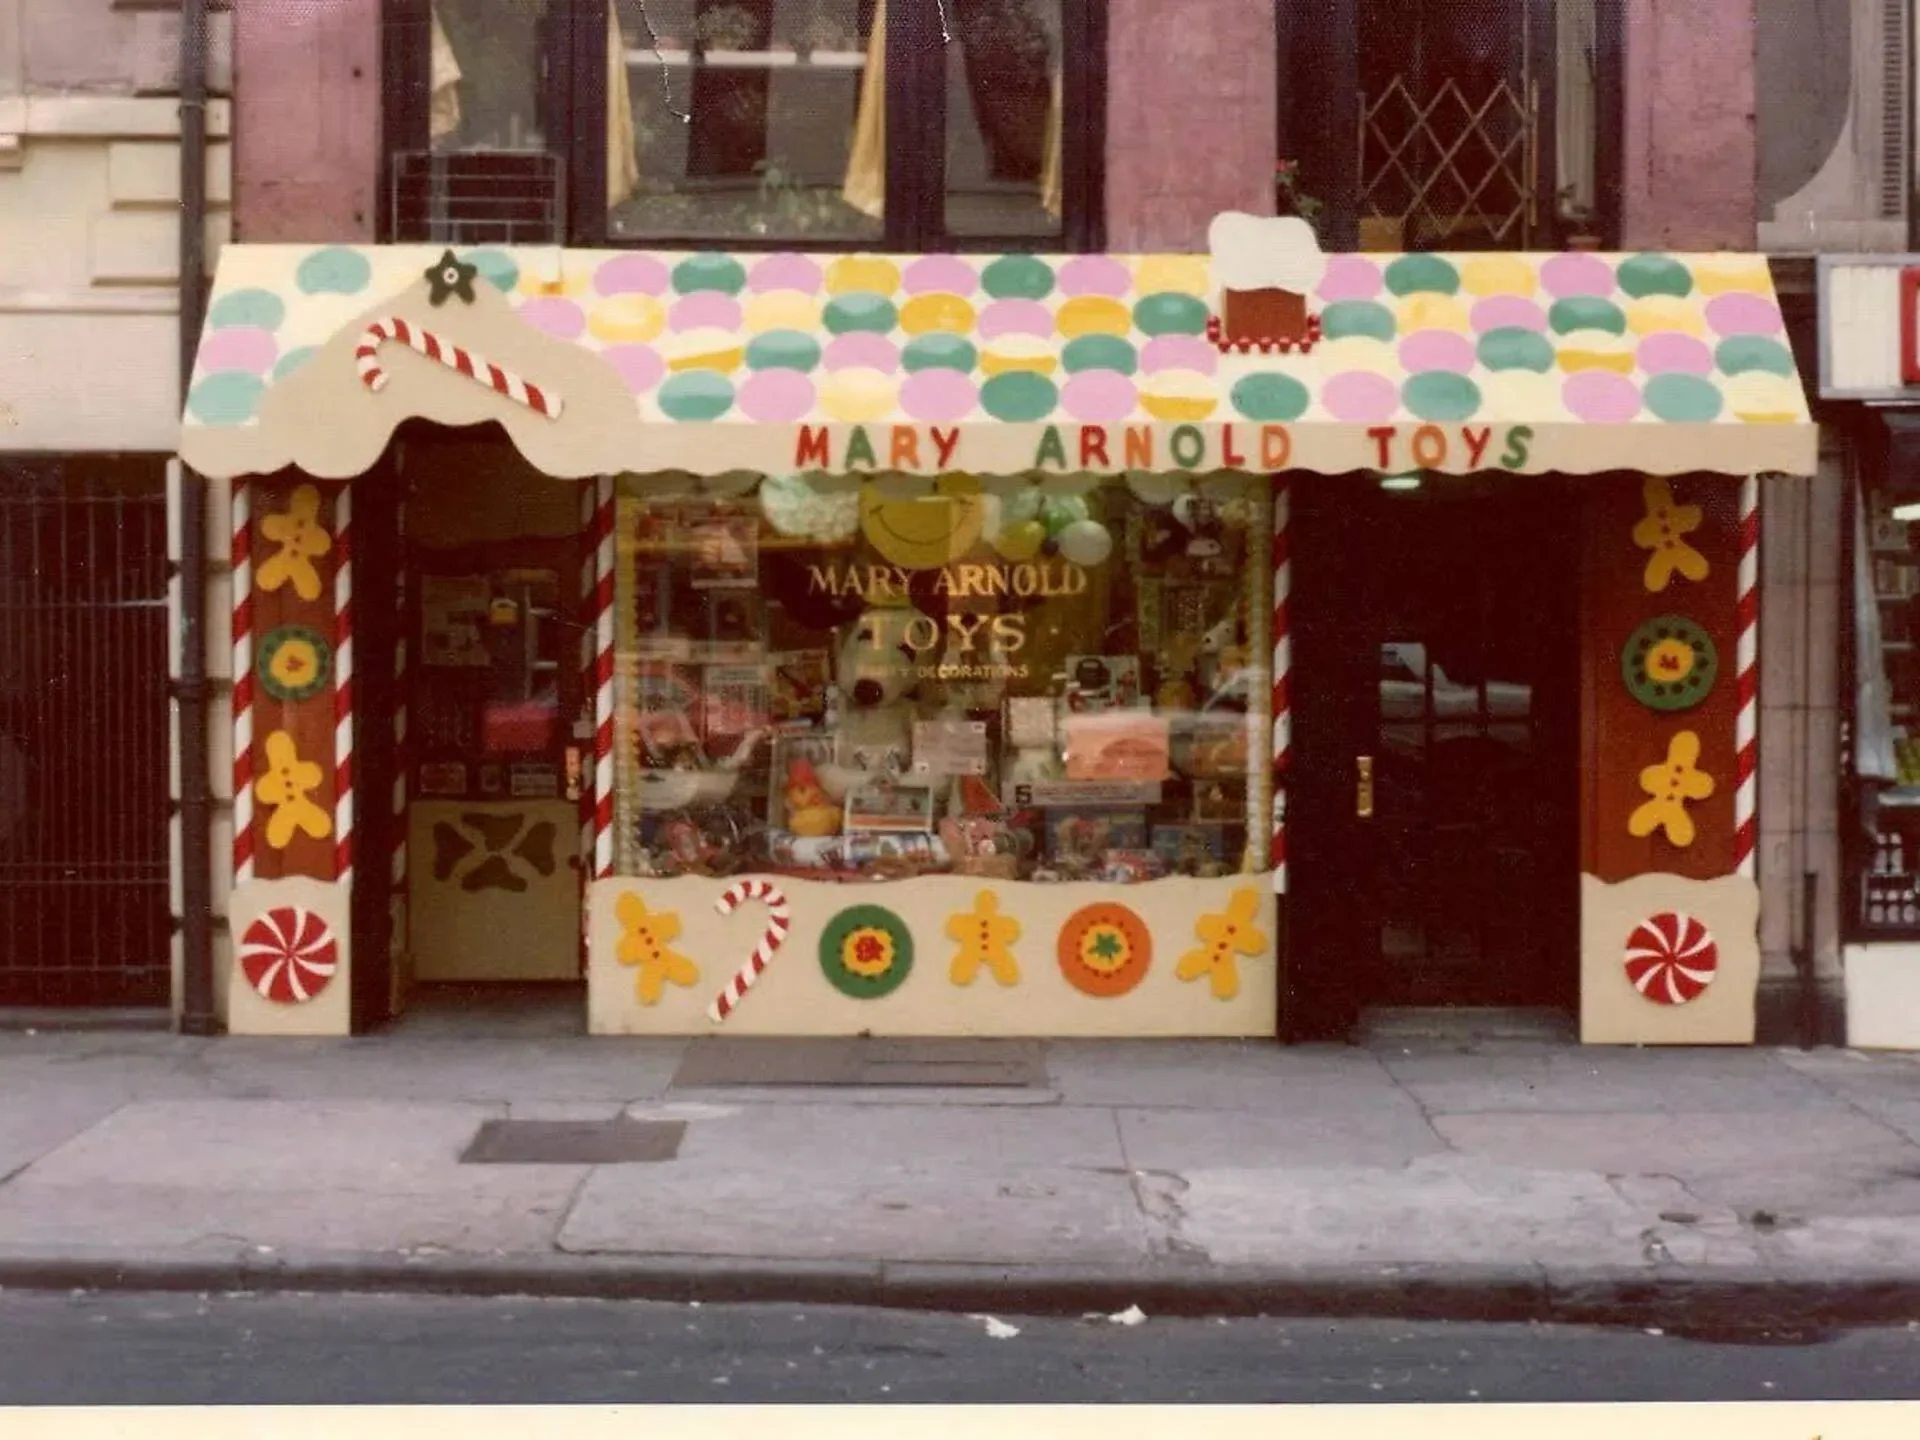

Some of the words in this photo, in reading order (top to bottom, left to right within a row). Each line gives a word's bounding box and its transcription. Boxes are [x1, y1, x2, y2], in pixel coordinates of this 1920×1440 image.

[795, 424, 960, 468] MARY
[1035, 423, 1291, 468] ARNOLD
[1367, 424, 1534, 469] TOYS
[808, 564, 916, 596] MARY
[933, 563, 1087, 596] ARNOLD
[860, 612, 1026, 651] TOYS
